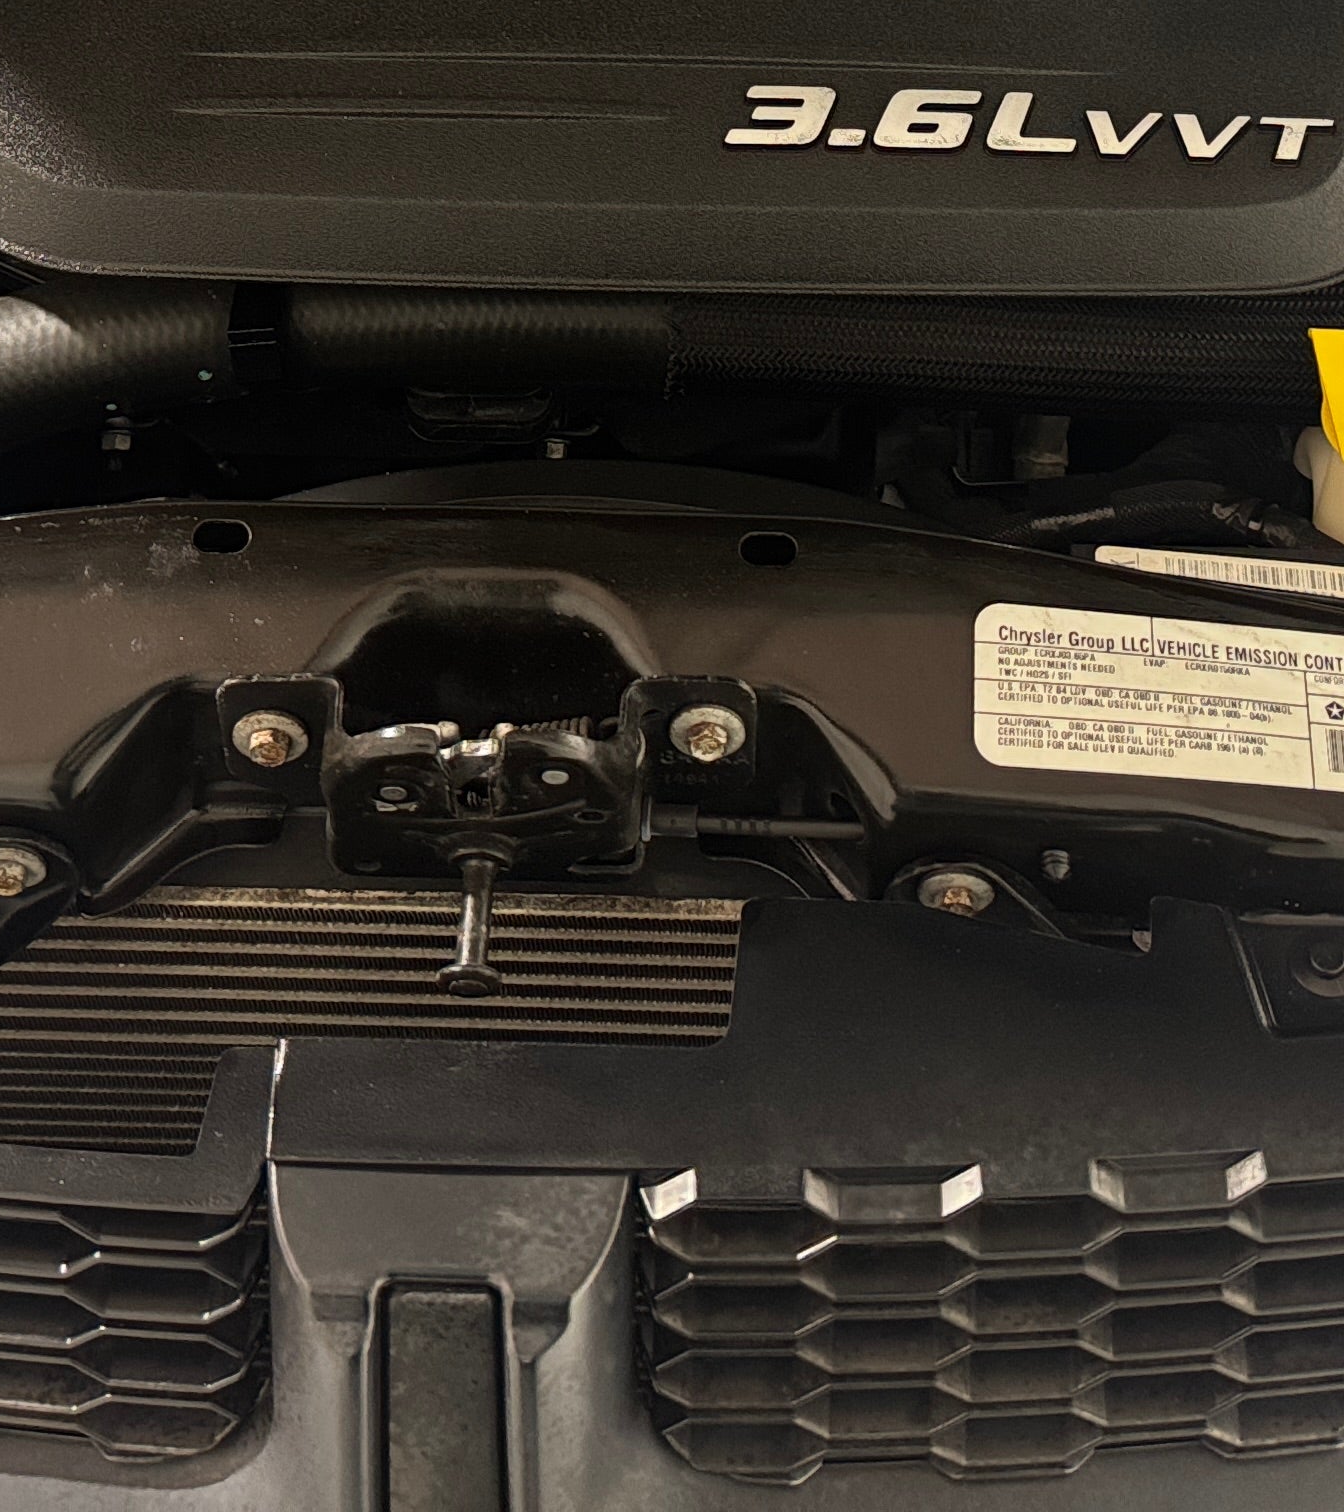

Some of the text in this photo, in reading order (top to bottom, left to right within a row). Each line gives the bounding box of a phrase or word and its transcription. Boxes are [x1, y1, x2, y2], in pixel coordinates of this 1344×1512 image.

[723, 84, 1336, 163] 3.6L VVT
[998, 625, 1151, 653] Chrysler Group LLC
[998, 657, 1116, 674] NO ADJUSTMENTS NEEDED
[1157, 639, 1219, 659] VEHICLE
[1226, 646, 1298, 668] EMISSION
[998, 668, 1019, 677] TWC
[1058, 672, 1072, 681] SFI
[998, 692, 1042, 704] CERTIFIED
[1047, 696, 1058, 705] TO
[1061, 697, 1105, 709] OPTIONAL
[1107, 700, 1143, 713] USEFUL
[1145, 703, 1164, 714] LIFE
[1166, 705, 1185, 716] PER
[1187, 707, 1206, 718] EPA
[1043, 686, 1053, 695] T2
[1119, 692, 1130, 702] CA
[1133, 693, 1151, 703] OBD
[1200, 698, 1243, 711] GASOLINE
[1252, 703, 1292, 715] ETHANOL
[998, 727, 1043, 740] CERTIFIED
[1047, 731, 1058, 741] TO
[1061, 732, 1106, 744] OPTIONAL
[1108, 736, 1143, 747] USEFUL
[1146, 738, 1165, 749] LIFE
[1168, 740, 1186, 751] PER
[1188, 742, 1212, 753] CARB
[998, 737, 1043, 750] CERTIFIED
[1047, 740, 1064, 751] FOR
[1067, 742, 1089, 753] SALE
[1092, 743, 1115, 755] ULEV
[1092, 724, 1104, 734] CA
[1107, 725, 1125, 735] OBD
[1174, 729, 1220, 742] GASOLINE
[1227, 733, 1269, 746] ETHANOL
